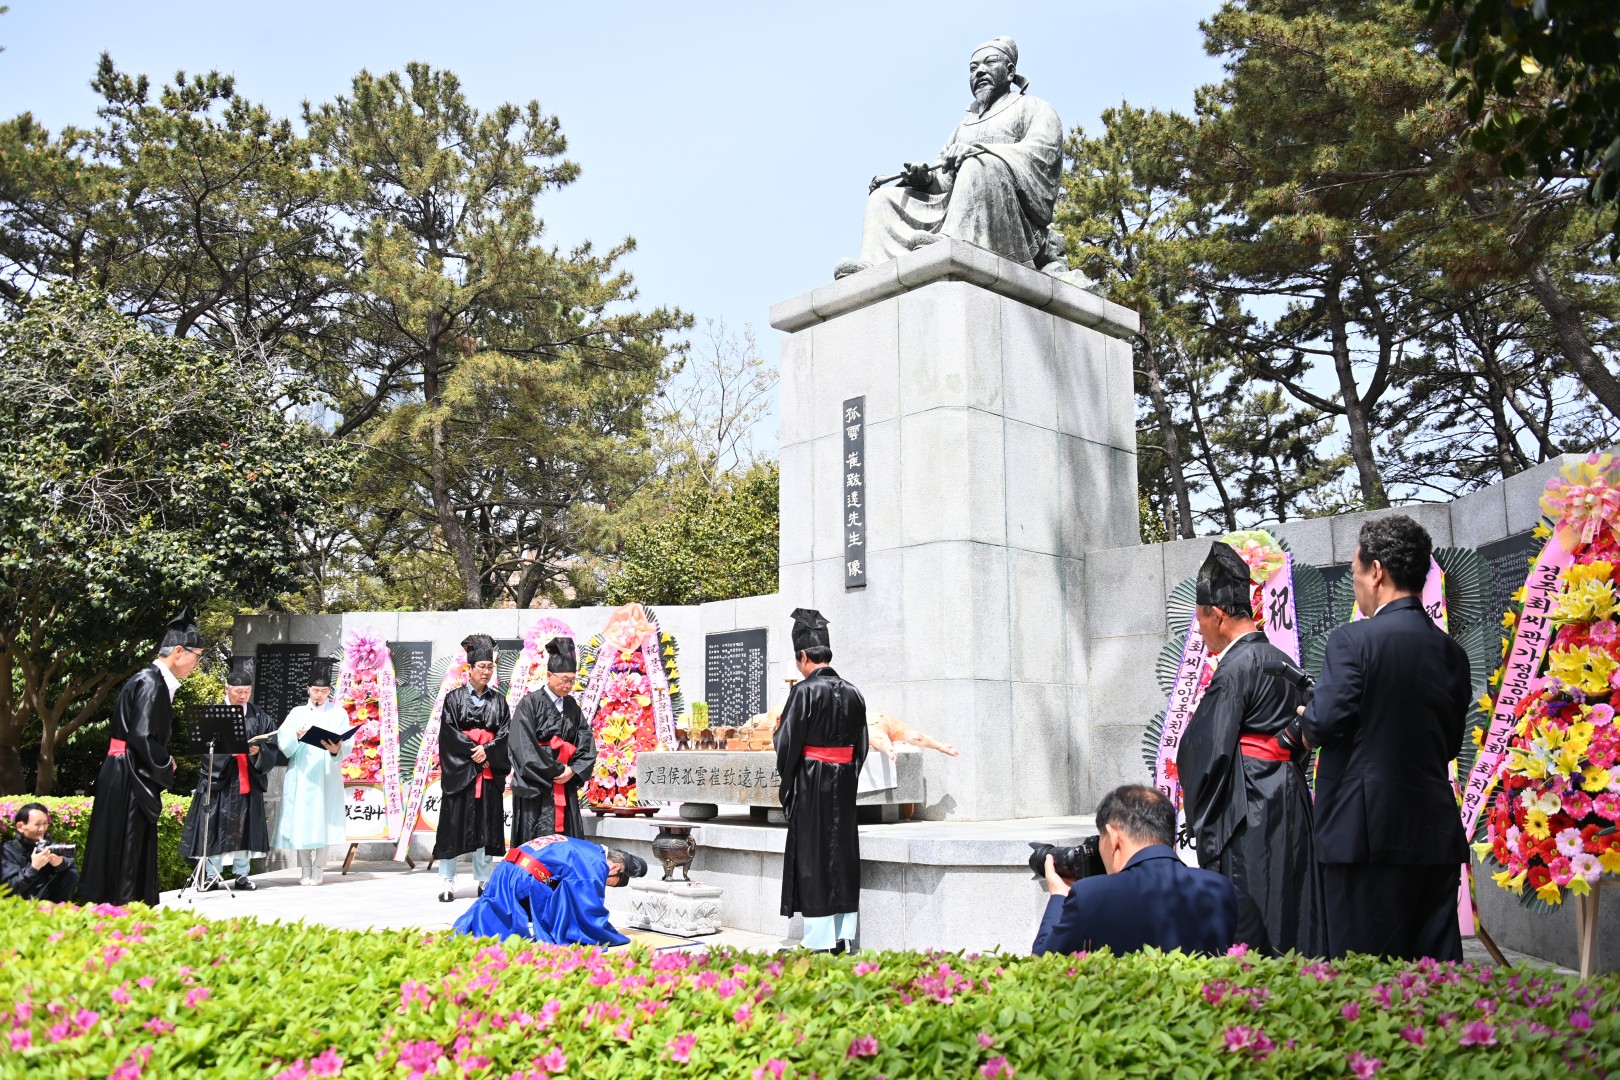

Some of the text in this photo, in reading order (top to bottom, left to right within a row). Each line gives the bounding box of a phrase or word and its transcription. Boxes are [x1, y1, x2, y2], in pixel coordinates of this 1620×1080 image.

[1269, 586, 1293, 632] 祝
[1425, 601, 1443, 619] 祝
[353, 788, 365, 802] 祝
